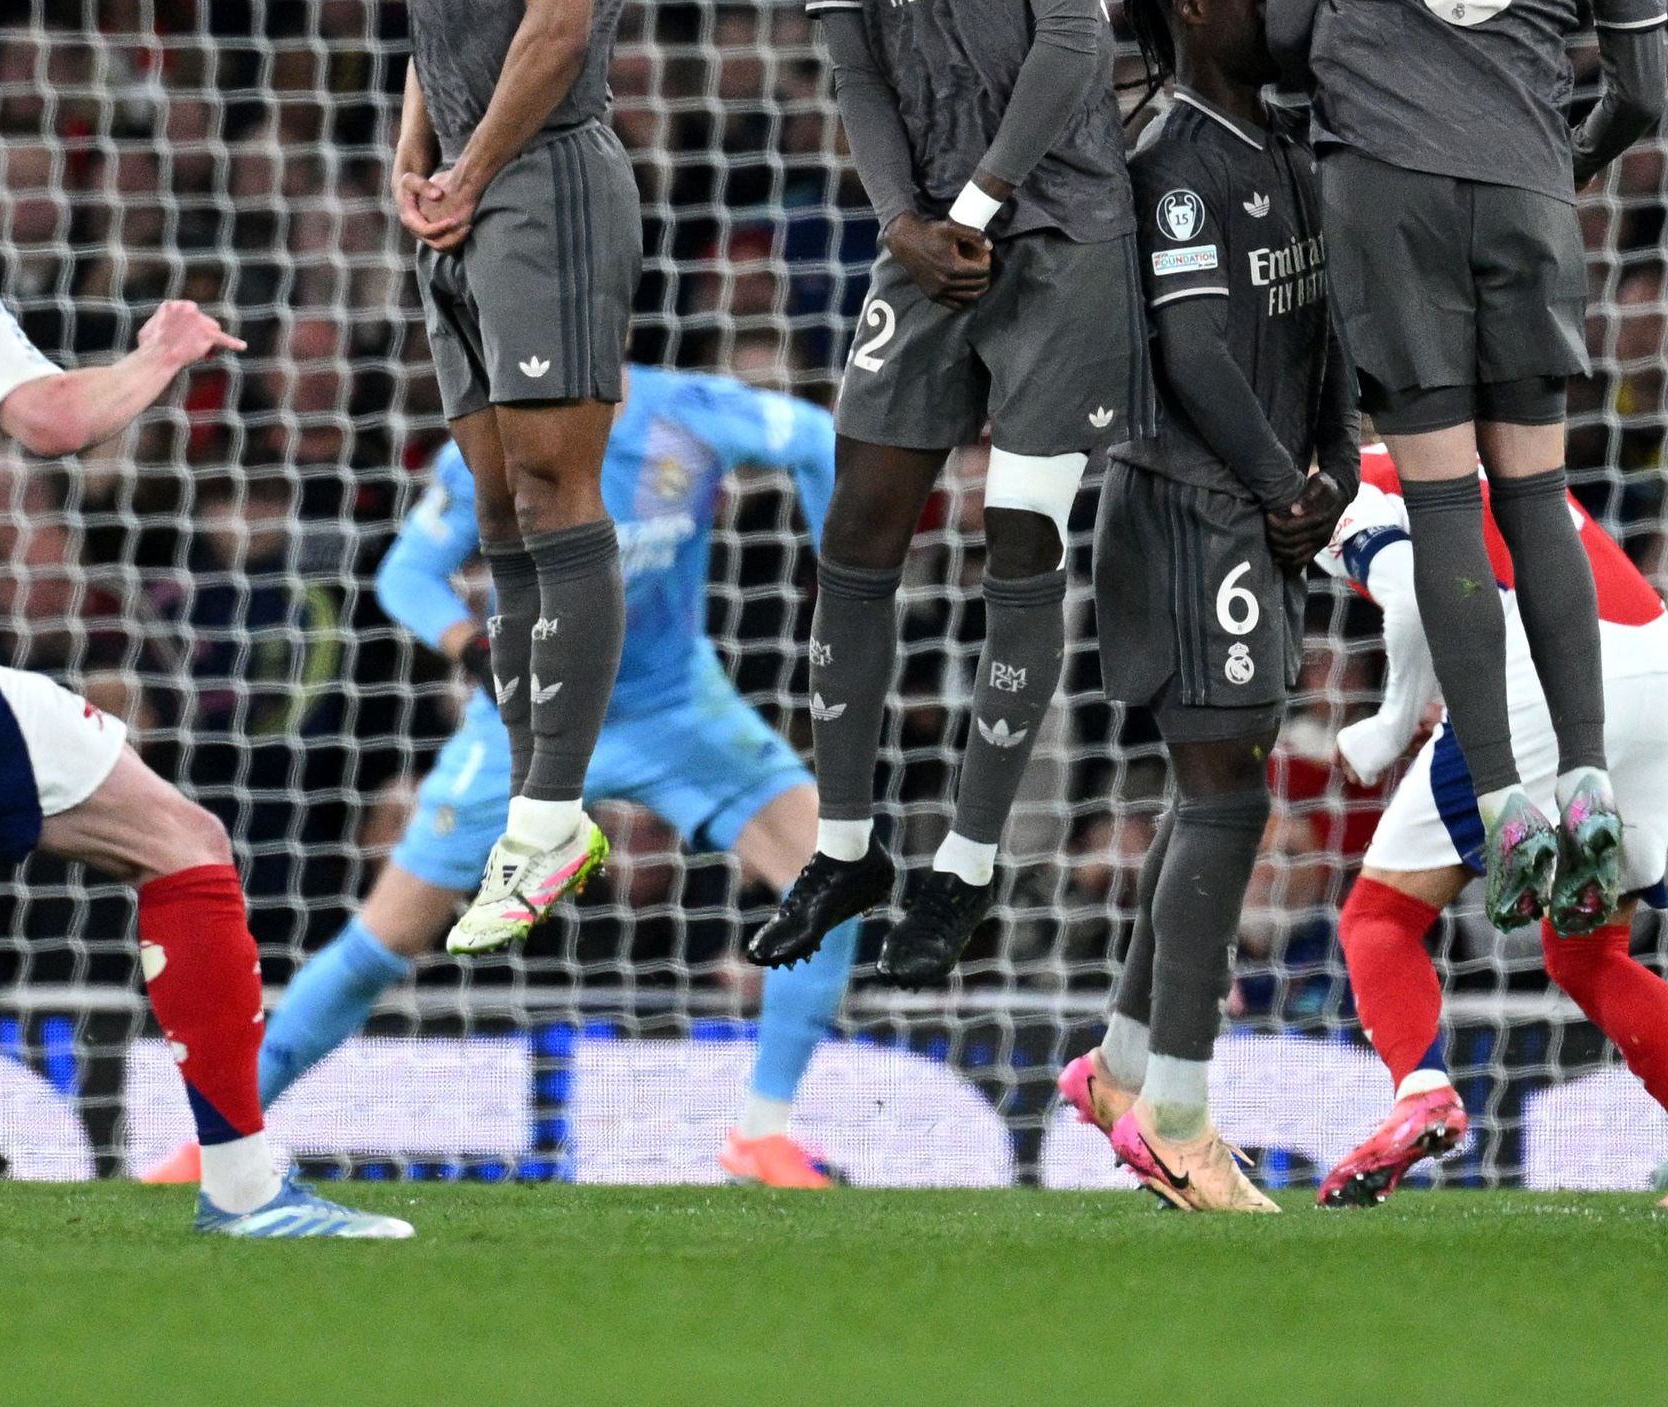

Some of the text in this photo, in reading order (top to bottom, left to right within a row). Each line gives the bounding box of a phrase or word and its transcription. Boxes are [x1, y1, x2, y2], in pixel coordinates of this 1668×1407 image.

[1154, 252, 1216, 269] FOUNDATION
[1248, 230, 1325, 286] Emirat
[1269, 282, 1293, 317] FLY
[848, 296, 895, 372] 2
[1216, 560, 1259, 635] 6
